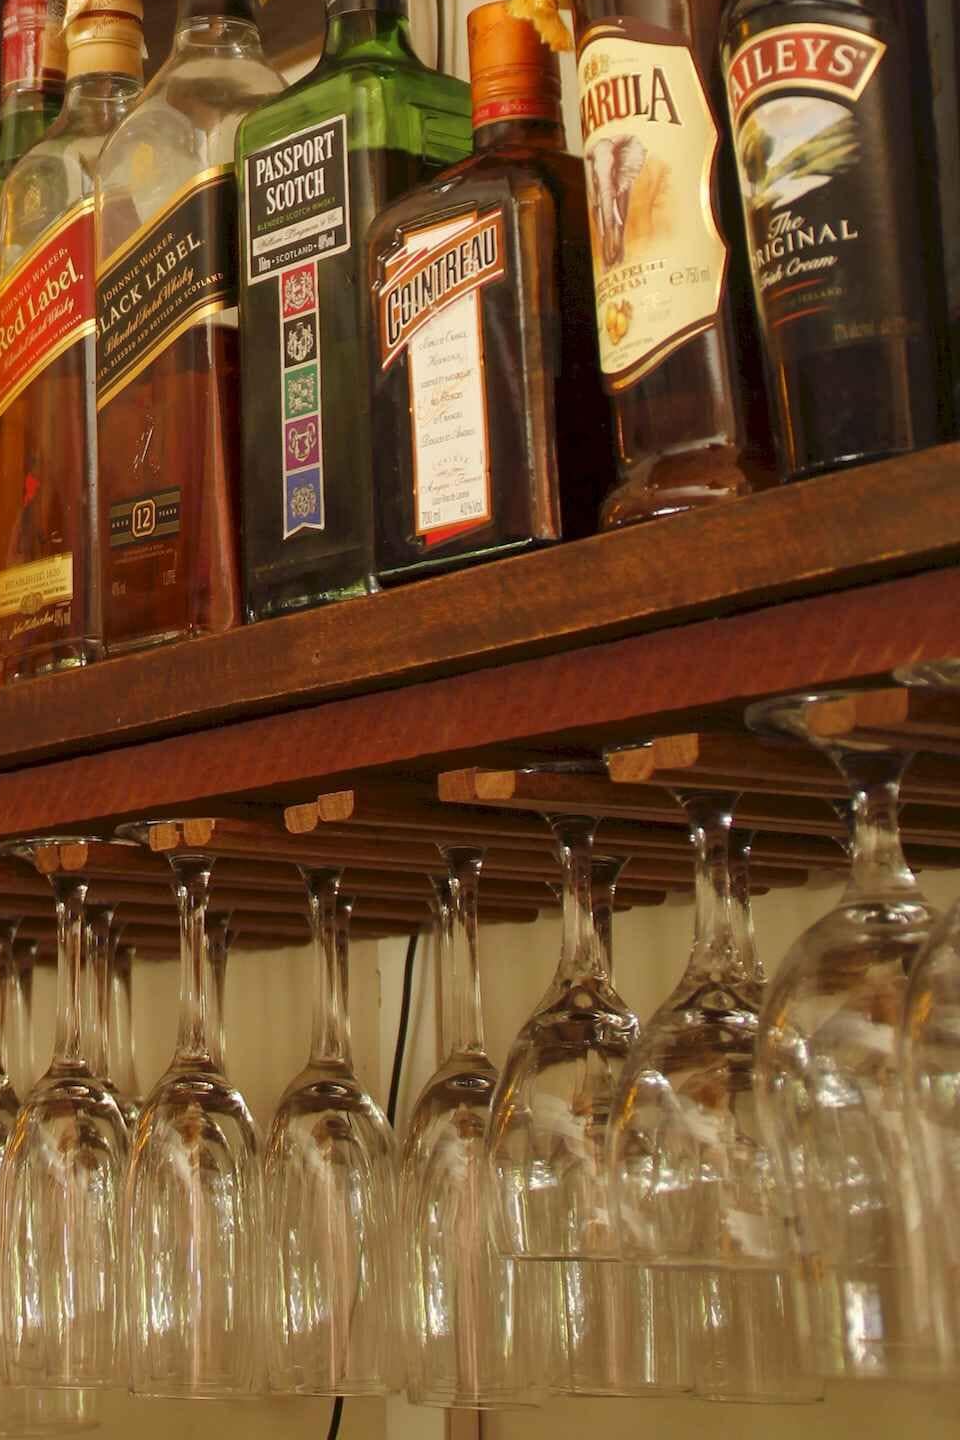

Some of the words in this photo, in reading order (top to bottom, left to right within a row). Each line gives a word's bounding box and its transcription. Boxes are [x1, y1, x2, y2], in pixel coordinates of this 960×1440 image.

[256, 130, 335, 187] PASSPORT
[266, 167, 326, 216] SCOTCH
[768, 210, 805, 239] The
[275, 243, 313, 265] SCOTLAND
[786, 255, 839, 276] Cream
[183, 272, 224, 300] SCOTLAND
[387, 225, 497, 347] COINTREAU
[137, 506, 151, 530] 12
